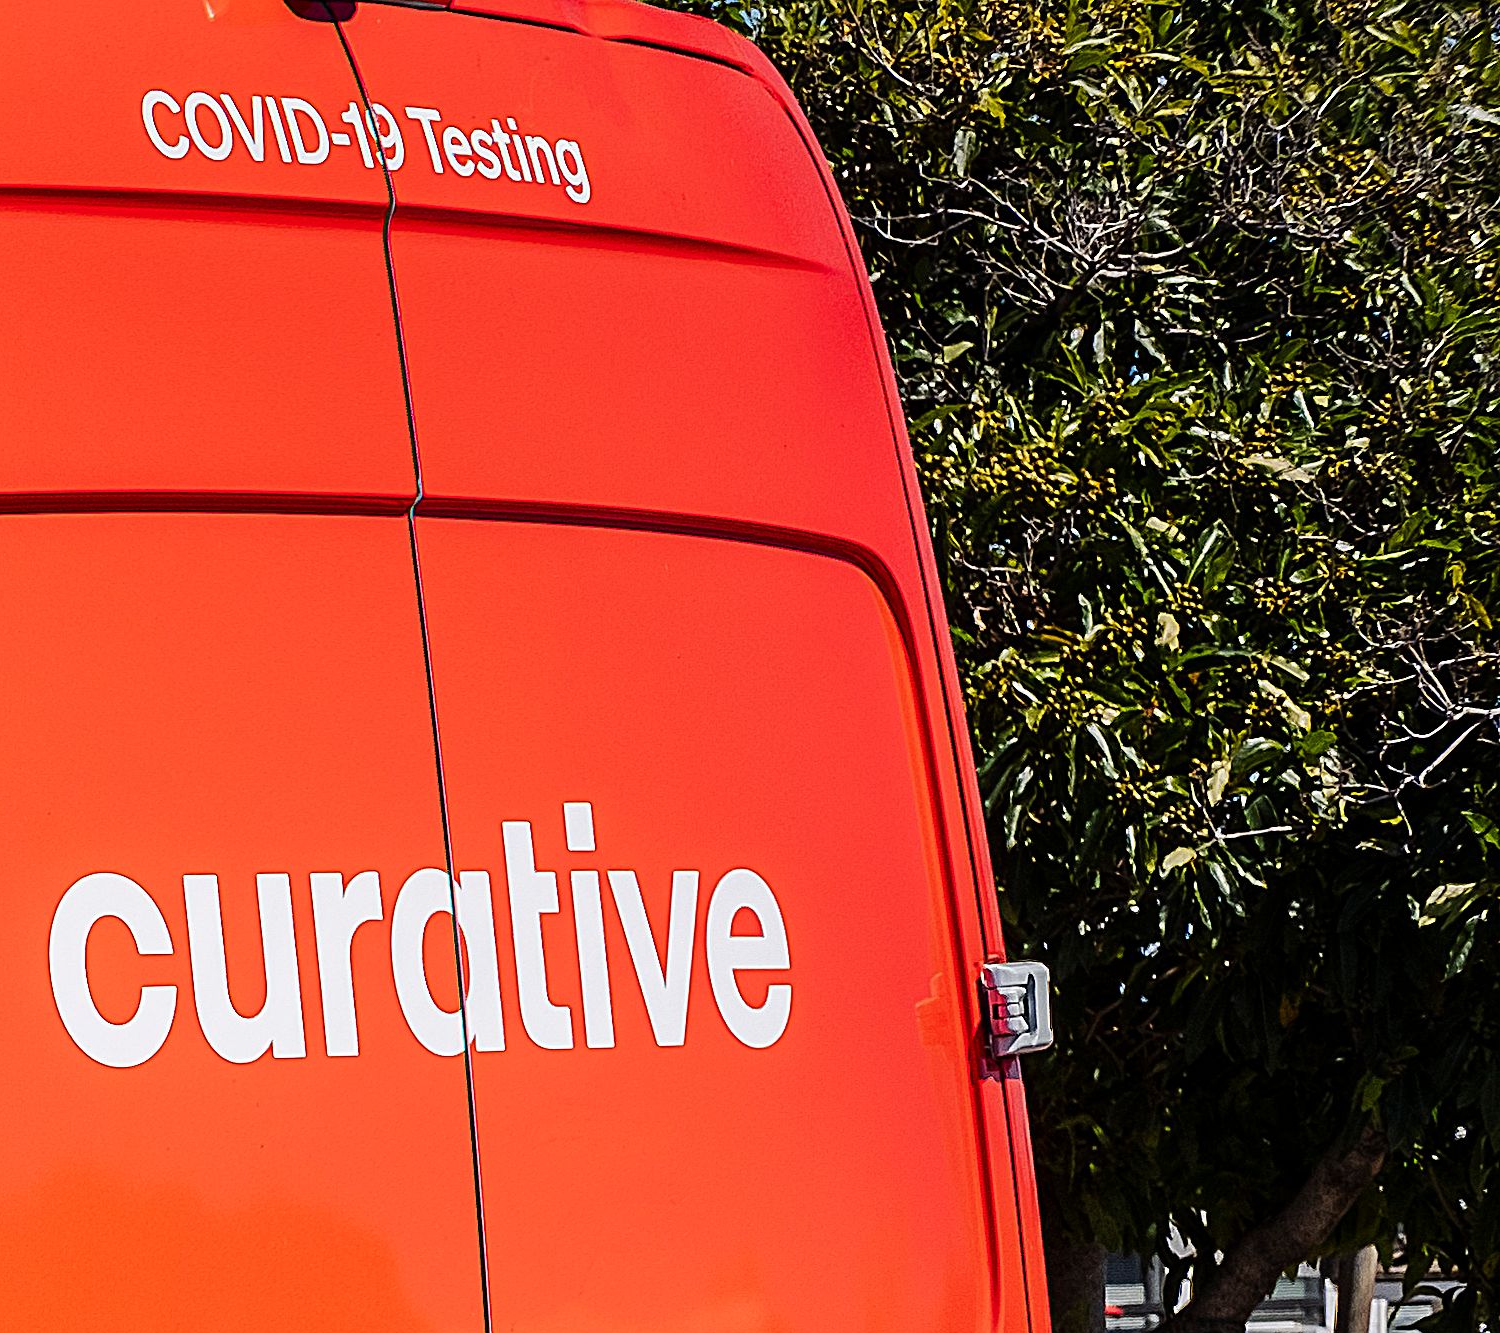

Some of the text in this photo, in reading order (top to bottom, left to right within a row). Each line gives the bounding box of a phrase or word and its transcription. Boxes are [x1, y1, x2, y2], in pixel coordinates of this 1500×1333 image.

[141, 90, 591, 204] COVID-19 Testing
[48, 802, 793, 1069] curative
